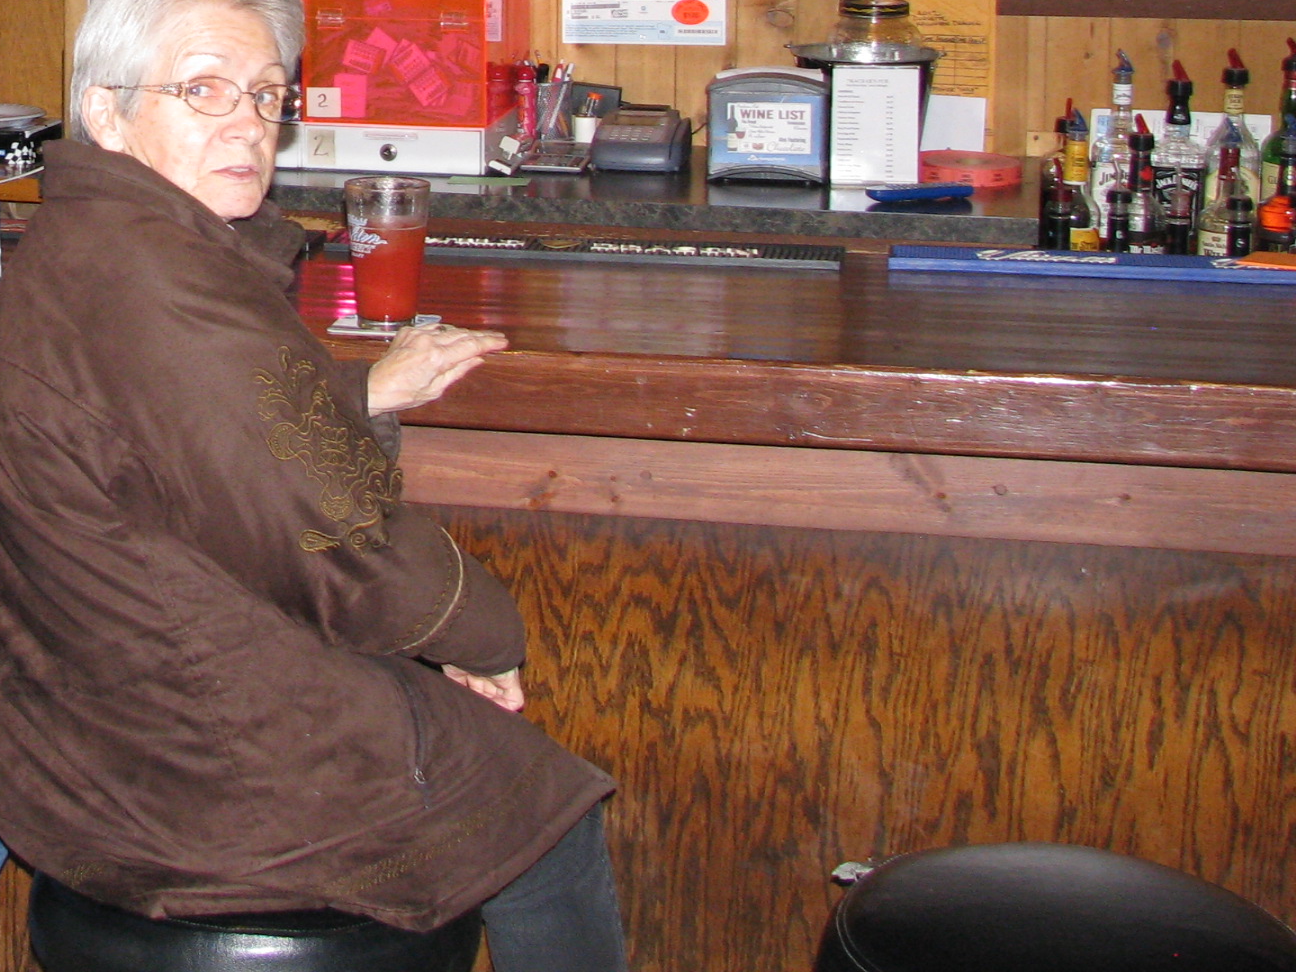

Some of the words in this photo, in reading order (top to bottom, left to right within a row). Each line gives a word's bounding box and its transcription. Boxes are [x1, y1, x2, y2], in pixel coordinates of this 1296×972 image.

[317, 93, 329, 108] 2
[740, 109, 774, 120] WINE
[778, 110, 806, 120] LIST
[313, 135, 330, 157] 2
